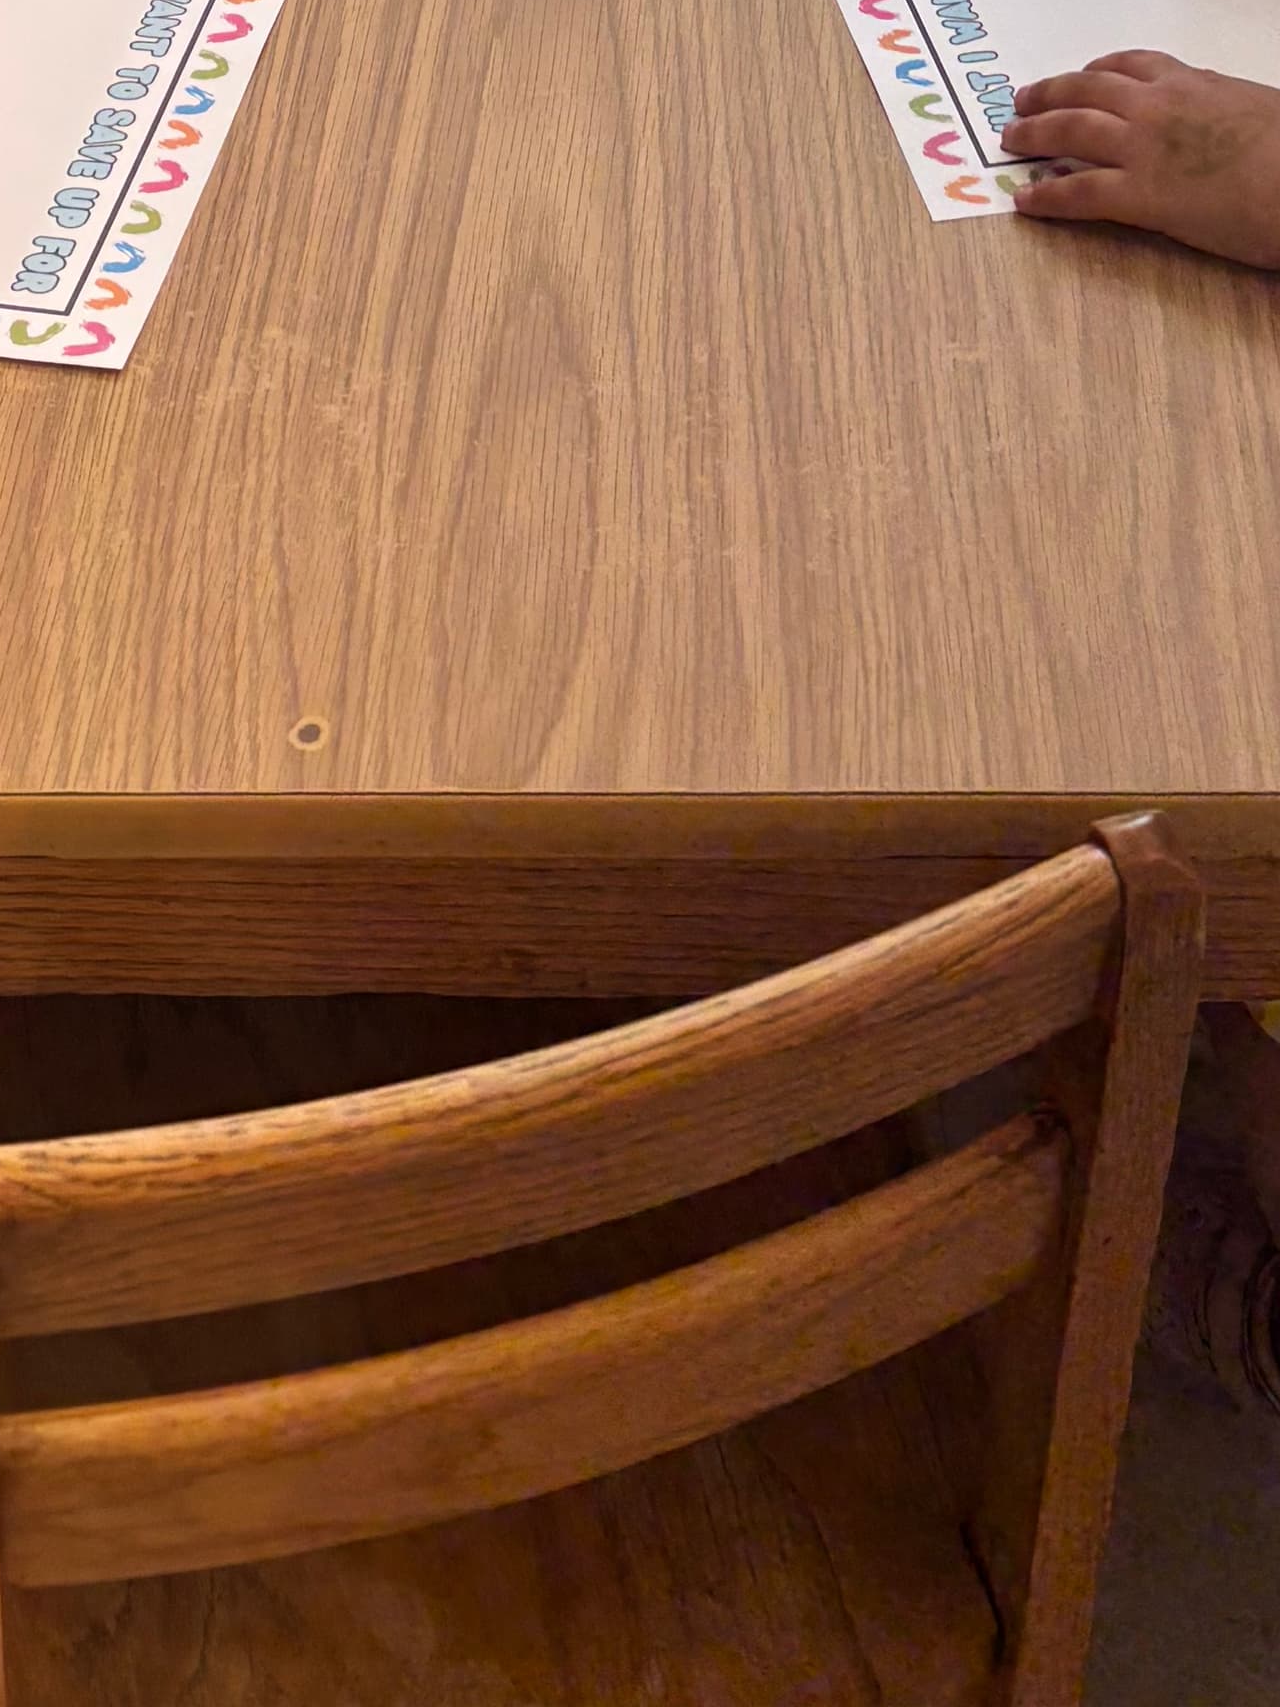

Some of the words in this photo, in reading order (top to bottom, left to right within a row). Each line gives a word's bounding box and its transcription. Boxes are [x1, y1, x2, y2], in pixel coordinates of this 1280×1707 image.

[958, 49, 999, 63] I
[106, 64, 160, 101] TO
[67, 108, 137, 180] SAVE
[48, 187, 100, 229] UP
[11, 235, 77, 294] FOR
